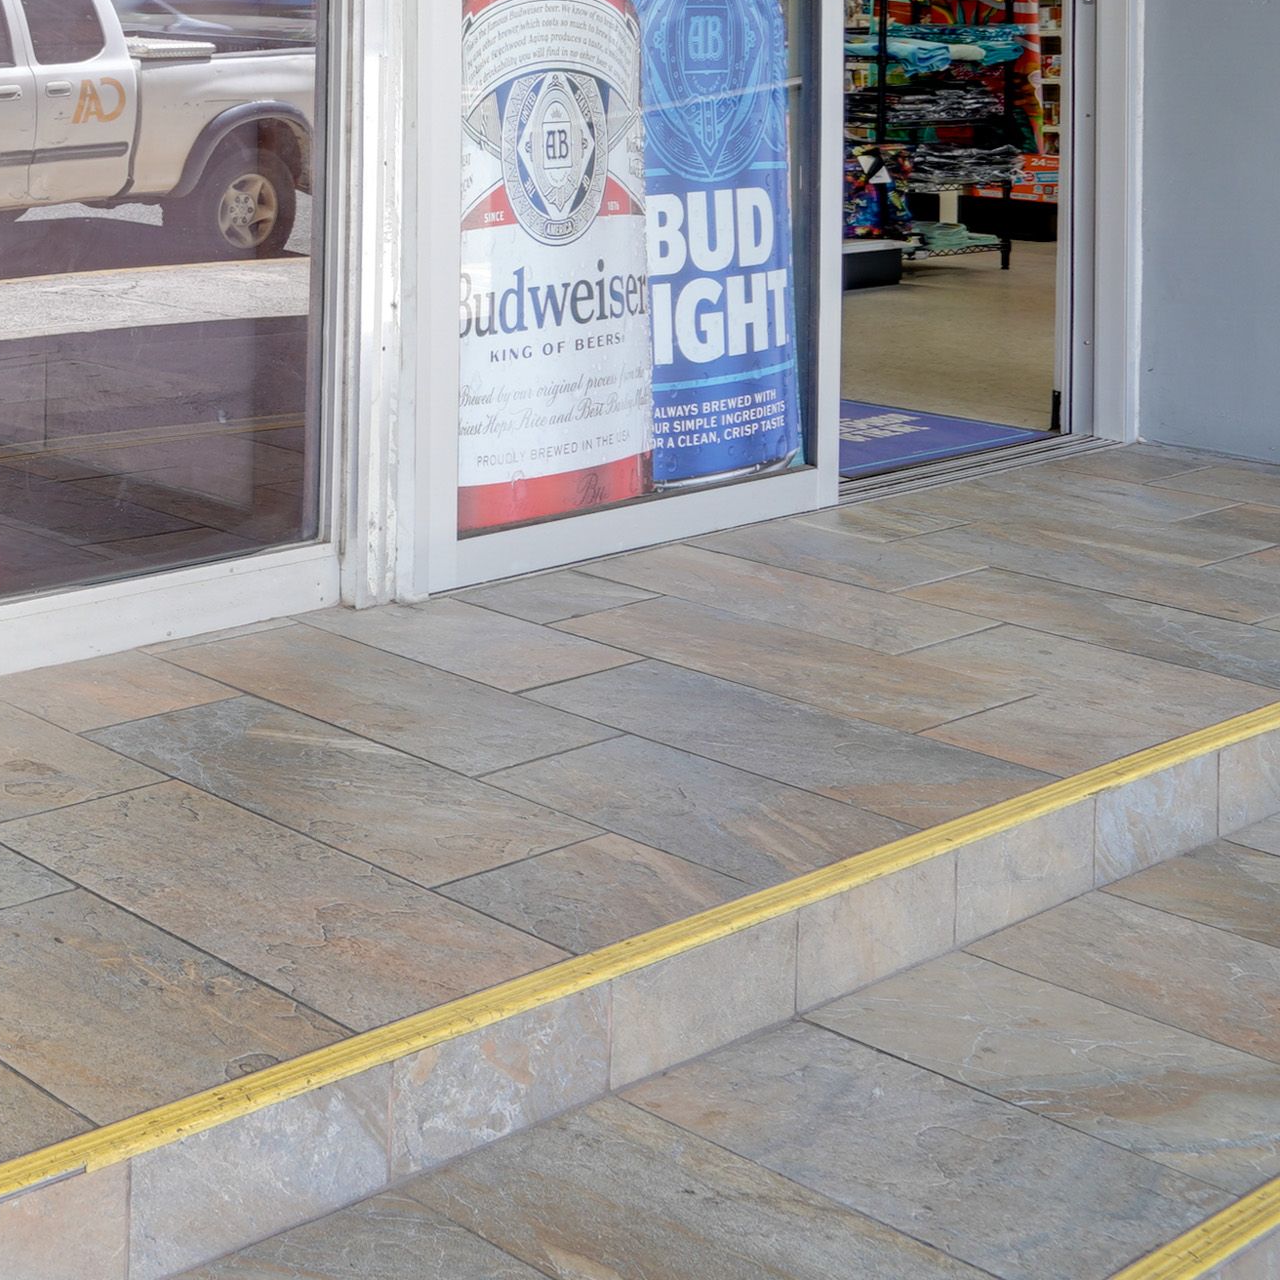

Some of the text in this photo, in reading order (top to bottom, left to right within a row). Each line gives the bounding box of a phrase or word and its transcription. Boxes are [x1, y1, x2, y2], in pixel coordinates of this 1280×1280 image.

[484, 211, 505, 223] SINCE
[645, 187, 774, 277] BUD
[652, 269, 788, 365] IGHT
[490, 333, 621, 363] KING OF BEERS
[654, 388, 777, 419] ALWAYS BREWED WITH
[673, 415, 718, 433] SIMPLE
[721, 400, 786, 426] INGREDIENTS
[666, 437, 675, 449] A
[678, 431, 721, 447] CLEAN,
[723, 424, 758, 440] CRISP
[761, 414, 786, 432] TASTE
[477, 451, 525, 468] PROUDLY
[531, 441, 578, 458] BREWED
[582, 438, 593, 449] IN
[596, 433, 614, 447] THE
